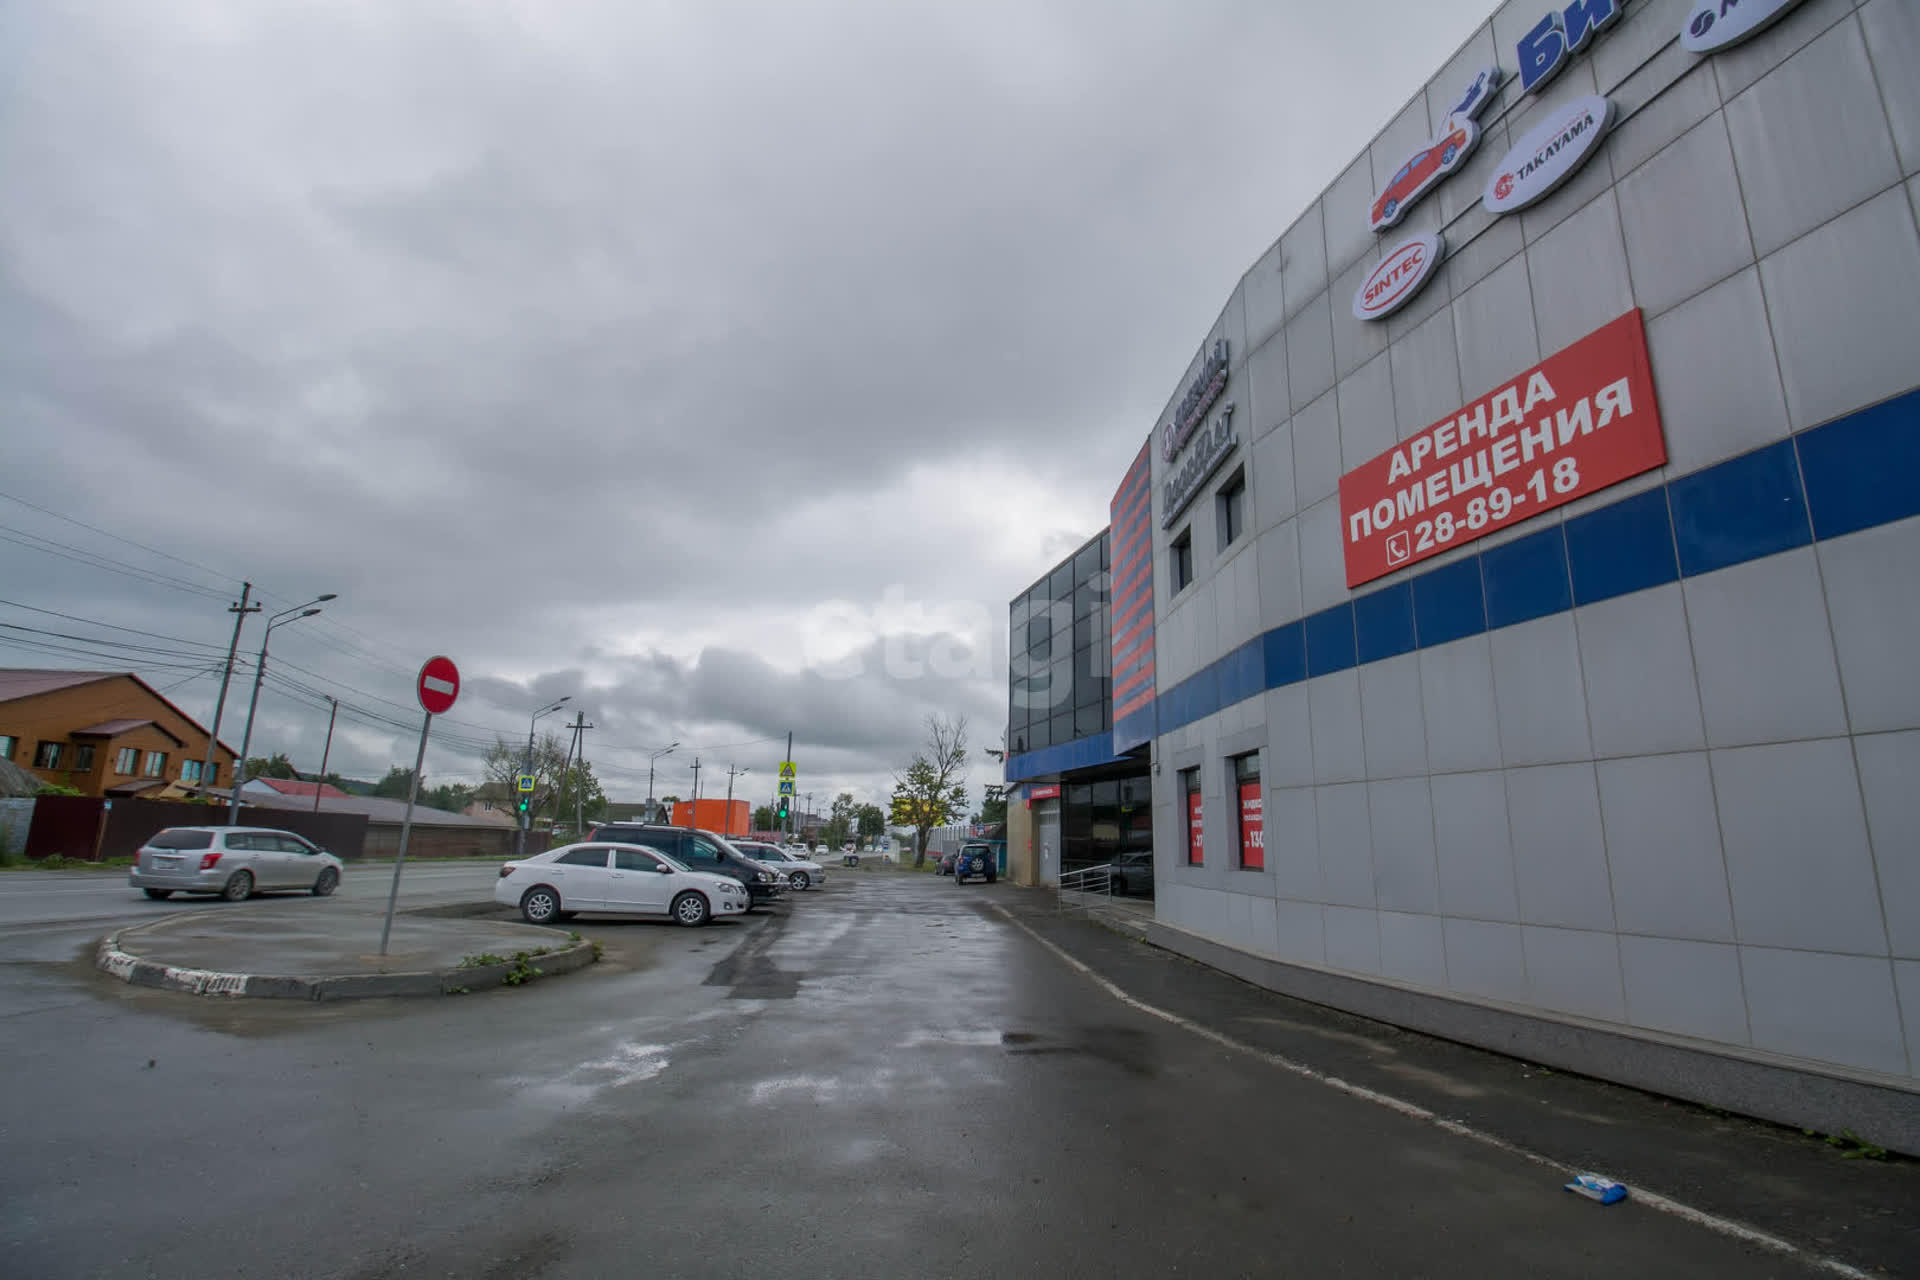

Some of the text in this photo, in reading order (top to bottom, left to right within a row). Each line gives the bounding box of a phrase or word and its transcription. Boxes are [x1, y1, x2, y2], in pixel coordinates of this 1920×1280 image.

[1517, 113, 1594, 180] TAKAYAMA
[1364, 247, 1422, 304] SINTEC
[1349, 376, 1633, 543] ПОМЕЩЕНИЯ
[1387, 370, 1557, 485] АРЕНДА
[1413, 456, 1580, 553] 28-89-18
